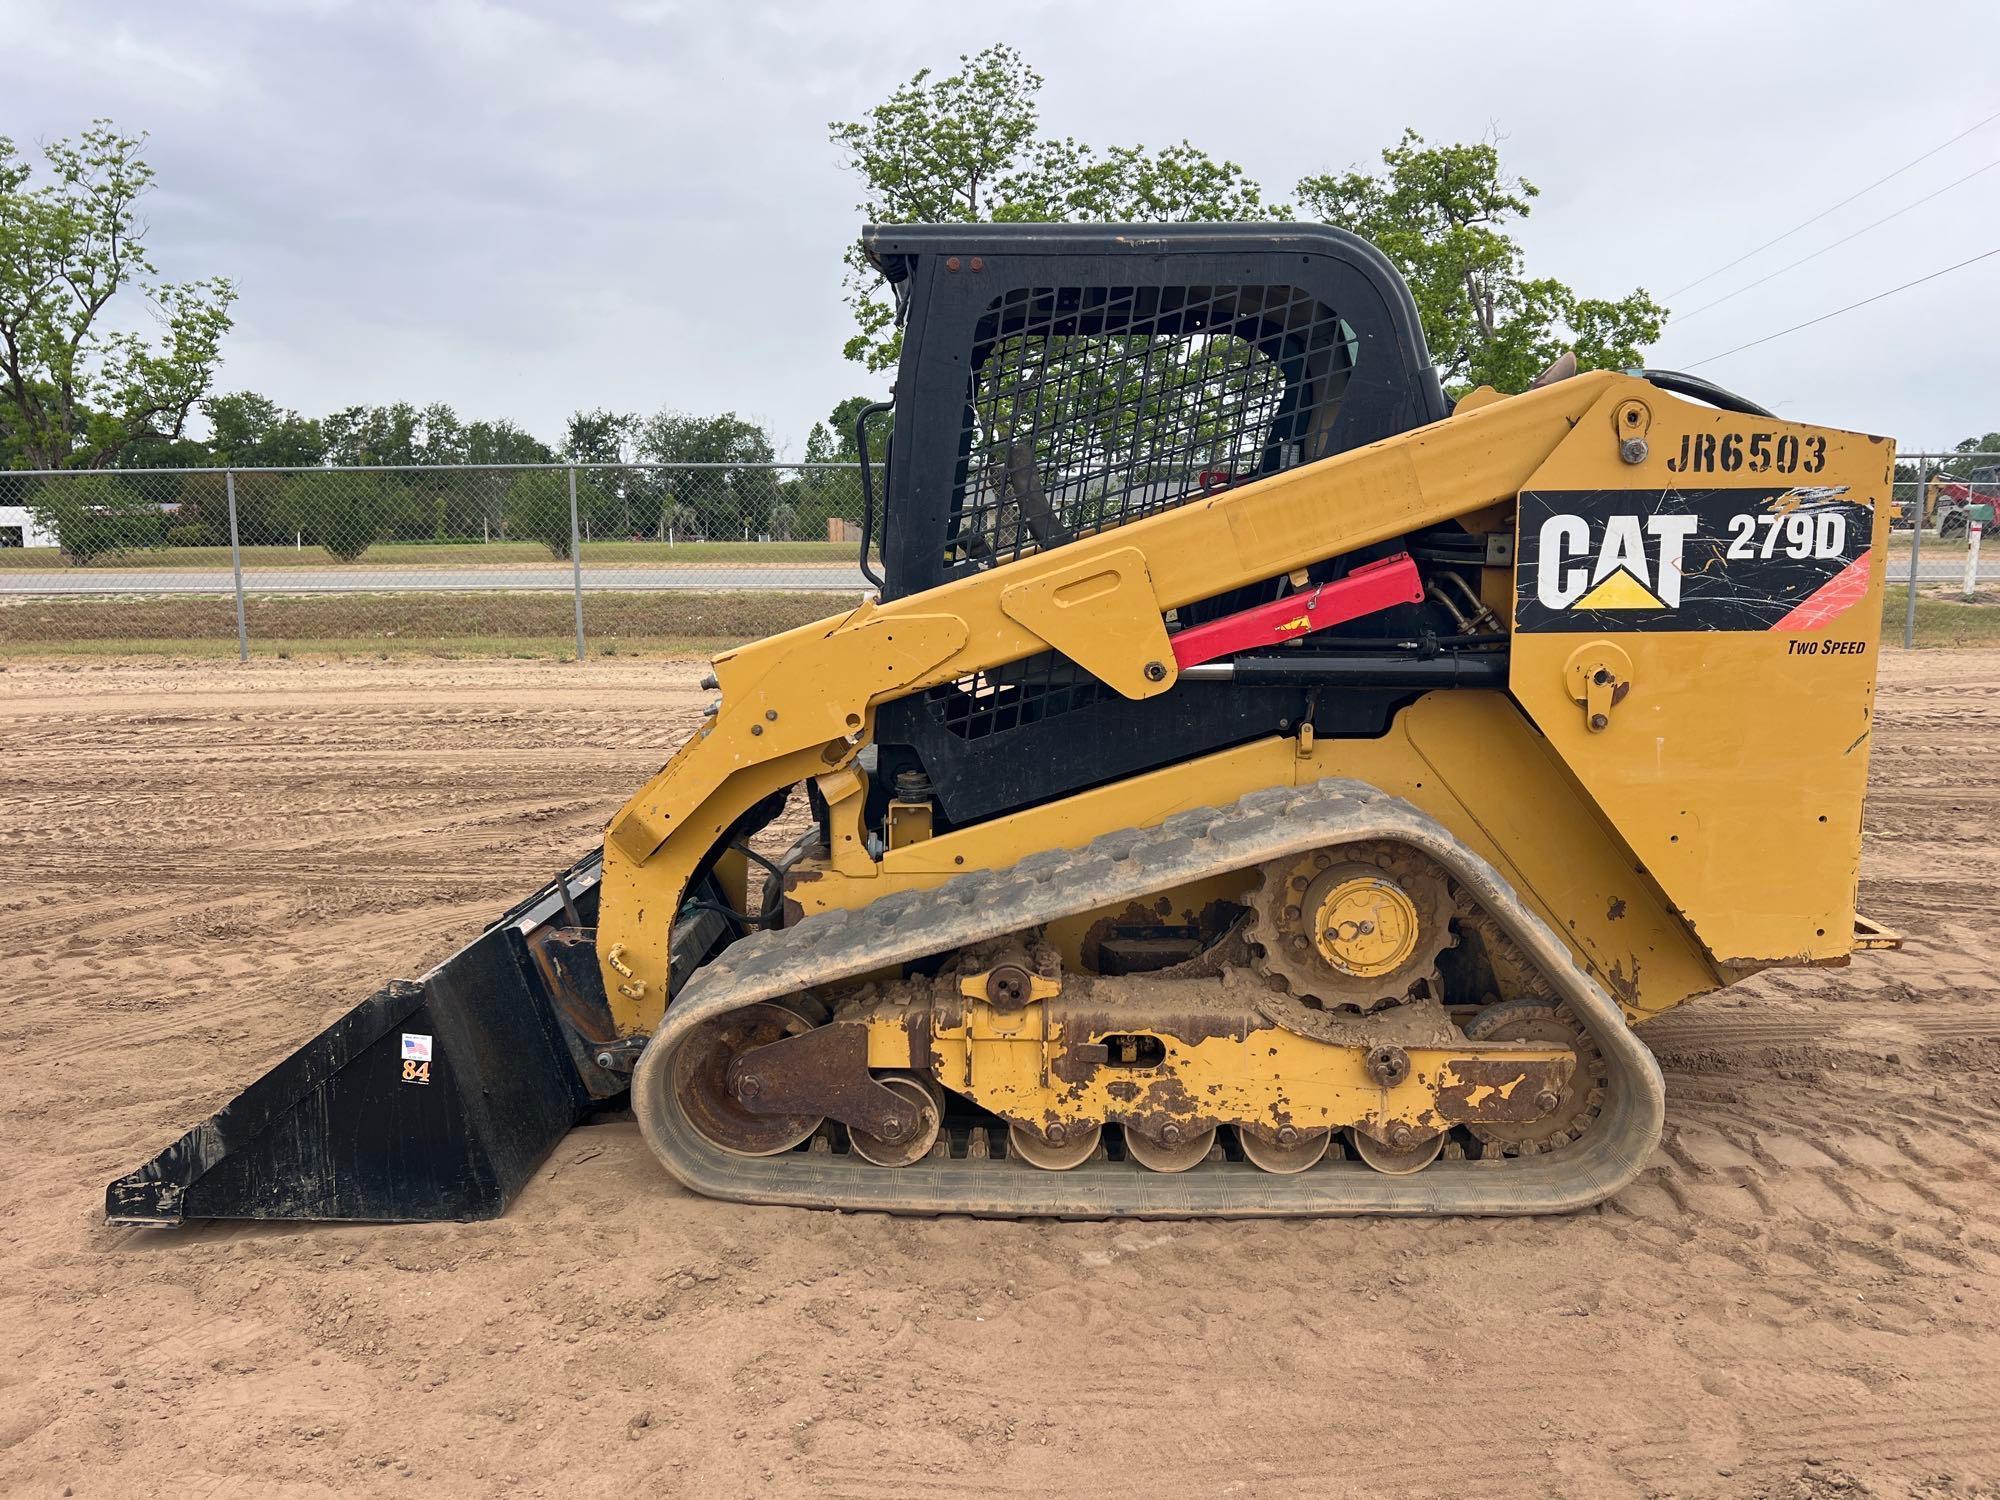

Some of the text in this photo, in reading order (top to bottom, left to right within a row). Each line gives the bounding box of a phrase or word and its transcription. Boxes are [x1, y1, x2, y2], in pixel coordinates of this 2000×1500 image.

[1667, 433, 1827, 473] JR6503
[1726, 513, 1846, 560] 279D
[1537, 513, 1698, 610] CAT
[402, 1060, 430, 1081] 84
